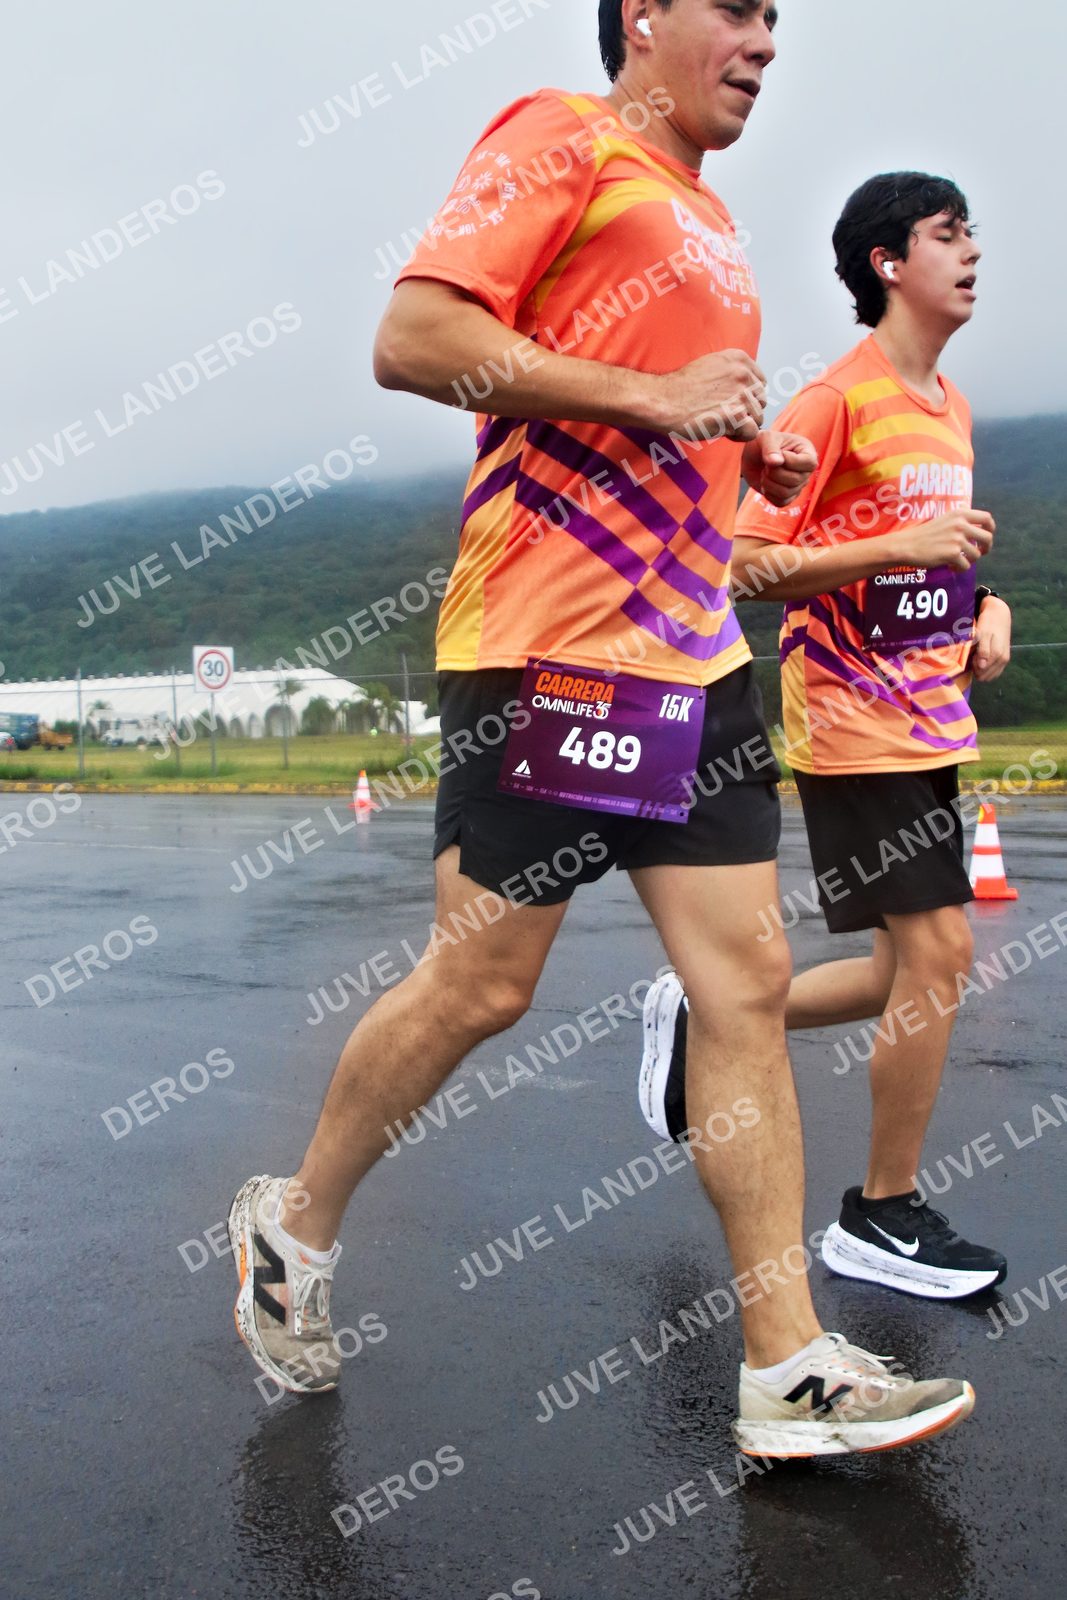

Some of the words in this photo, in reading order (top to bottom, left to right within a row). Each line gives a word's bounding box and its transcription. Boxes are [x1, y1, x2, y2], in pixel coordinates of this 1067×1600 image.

[896, 588, 948, 619] 490
[203, 660, 224, 677] 30
[535, 671, 615, 704] CARRERA
[658, 693, 694, 722] 15K
[558, 726, 641, 773] 489
